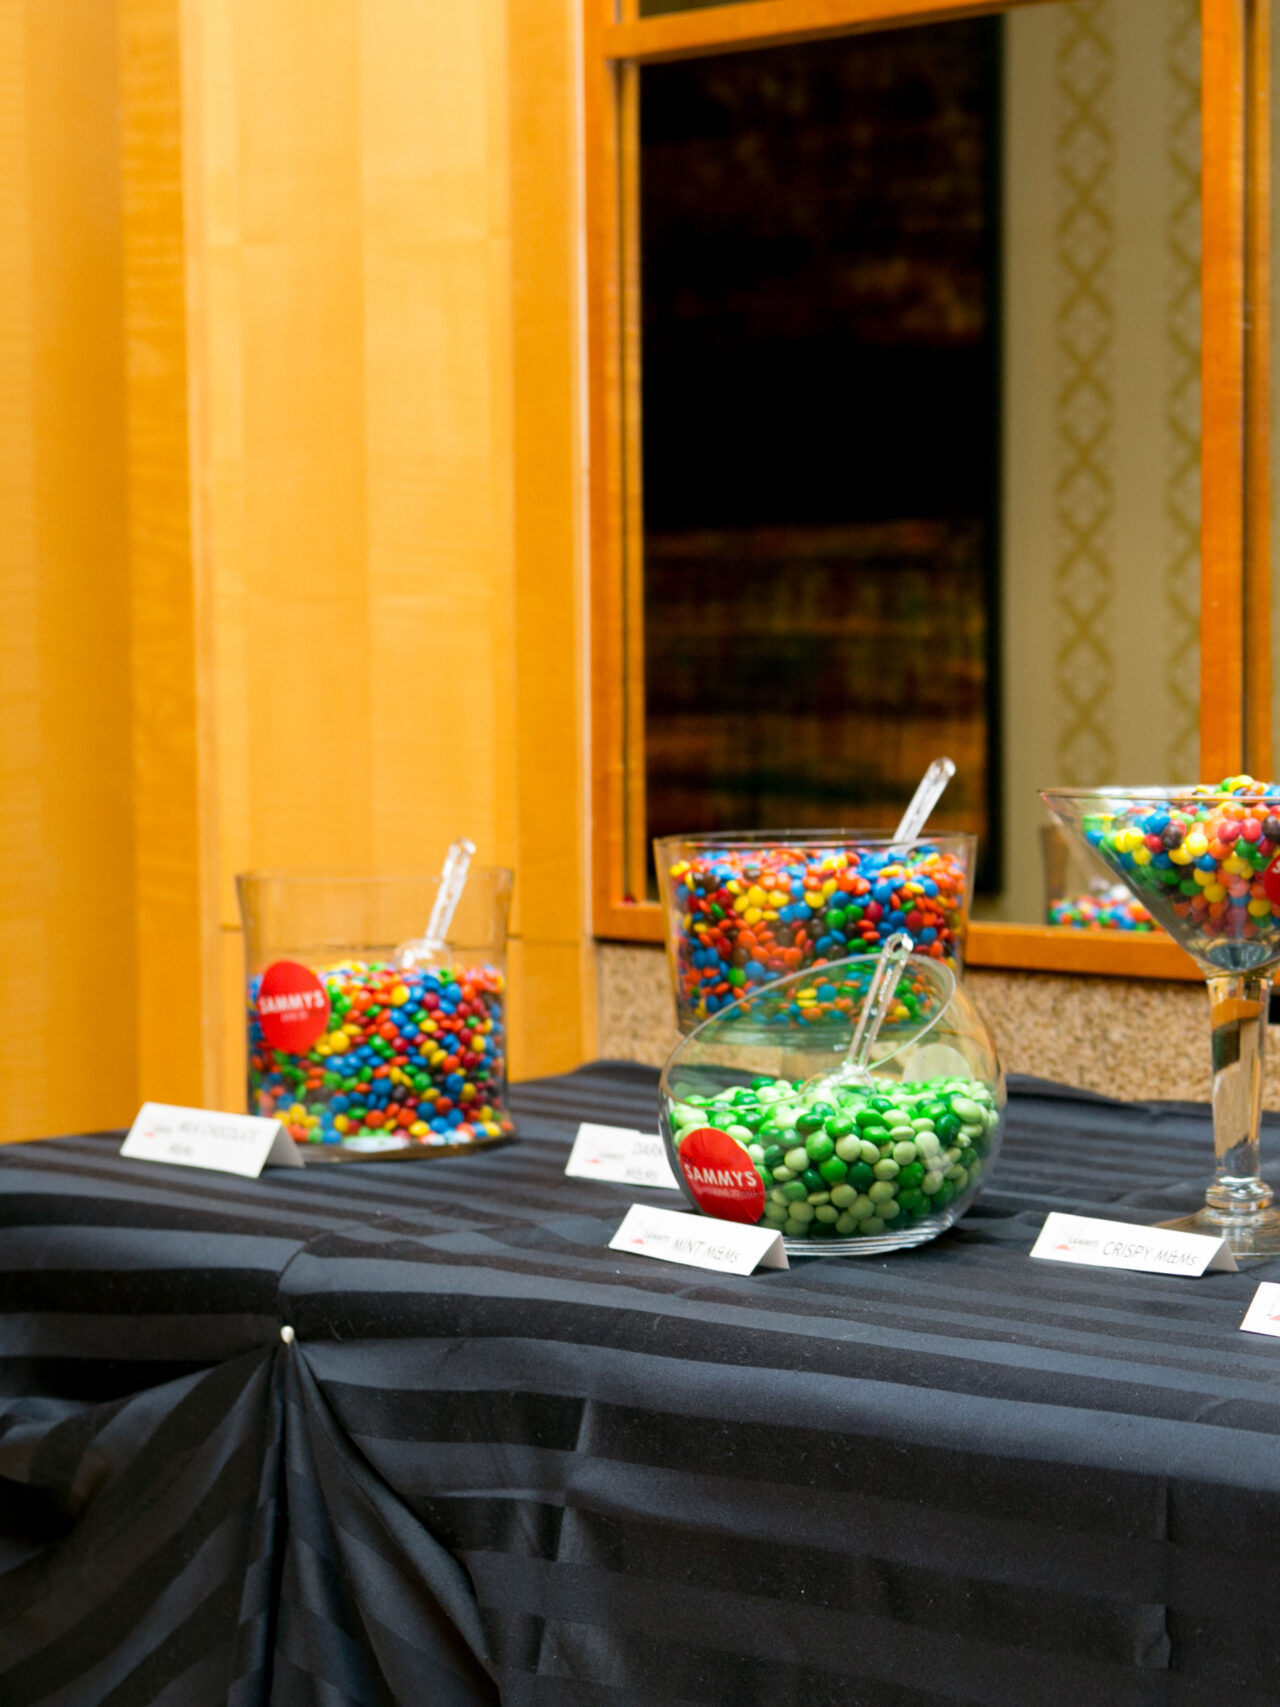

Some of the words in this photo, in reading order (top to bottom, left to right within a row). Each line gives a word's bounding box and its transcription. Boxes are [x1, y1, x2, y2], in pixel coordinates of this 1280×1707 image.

[684, 1163, 757, 1187] SAMMYS
[671, 1238, 706, 1255] MINT
[1102, 1241, 1153, 1260] CRISPY
[1154, 1249, 1199, 1266] M&Ms
